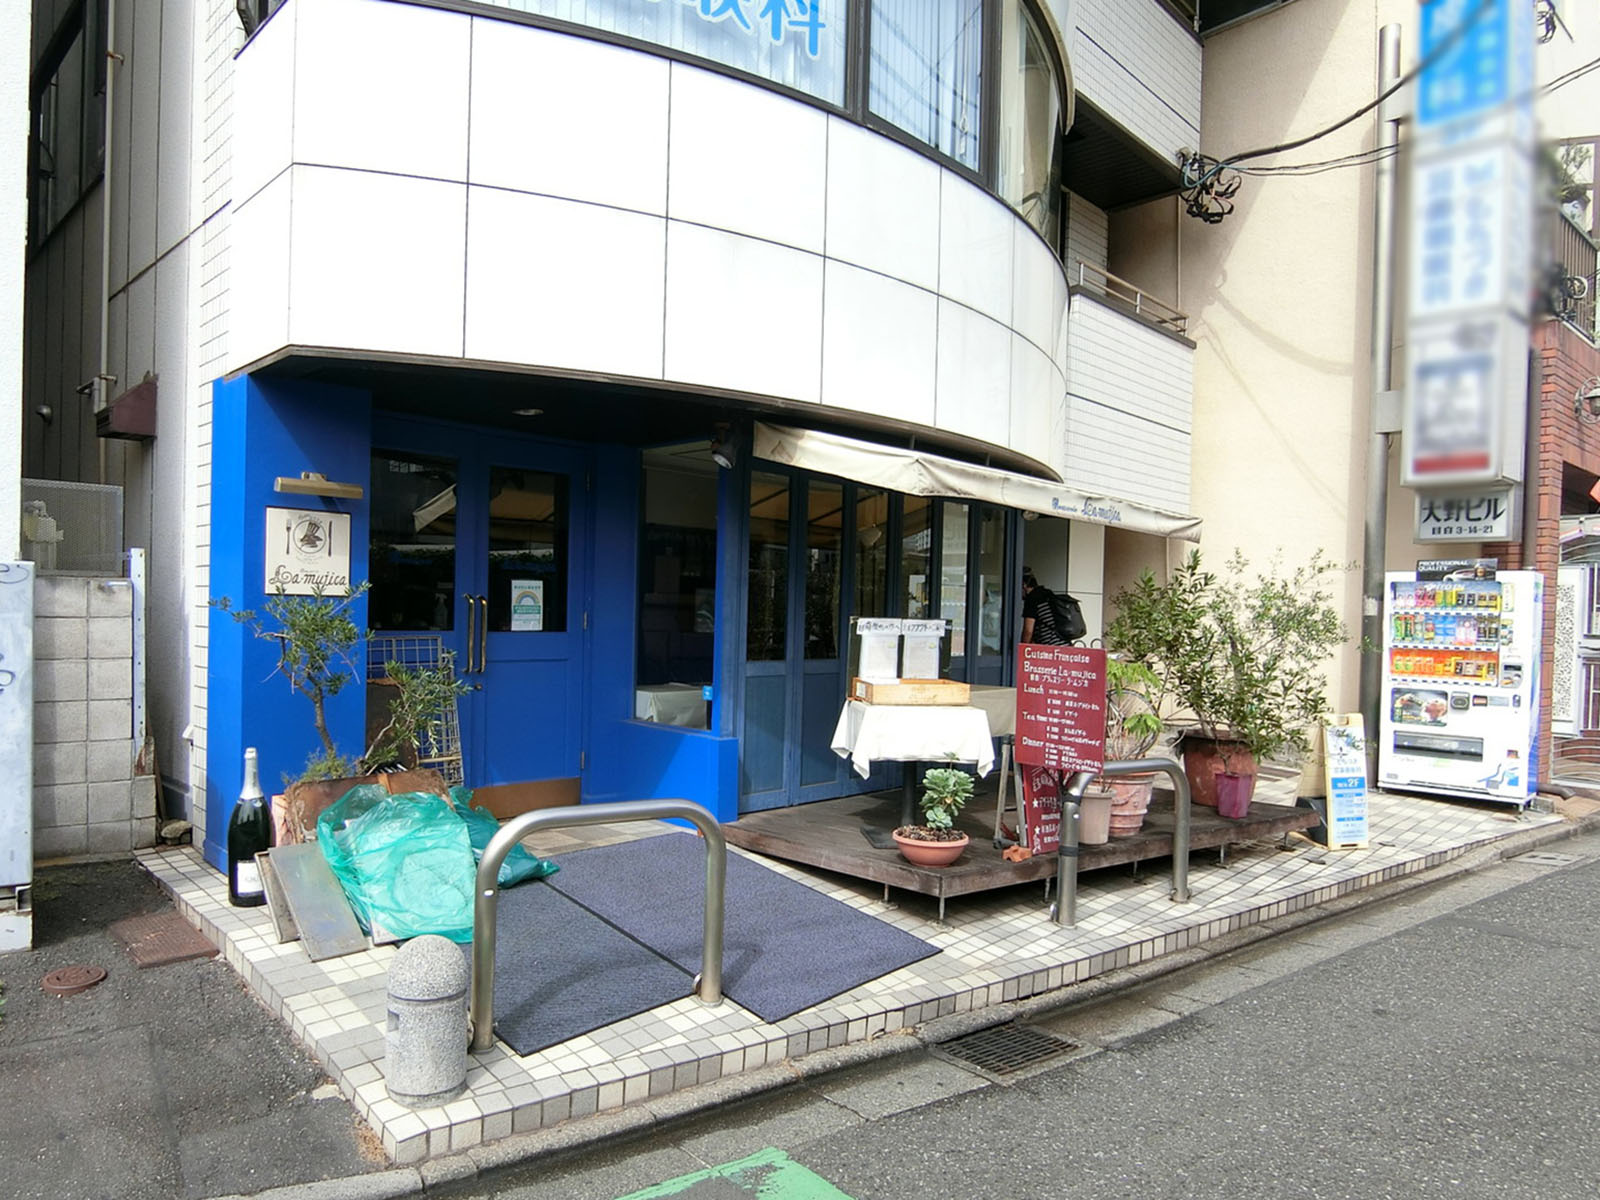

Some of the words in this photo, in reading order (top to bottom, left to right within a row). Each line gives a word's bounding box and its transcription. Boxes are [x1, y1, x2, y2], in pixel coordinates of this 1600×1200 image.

[1421, 497, 1507, 524] 大野ビル
[1024, 647, 1053, 661] Cuisine
[1023, 683, 1045, 695] Lunch
[1022, 736, 1044, 748] Dinner
[1347, 778, 1360, 788] 2F
